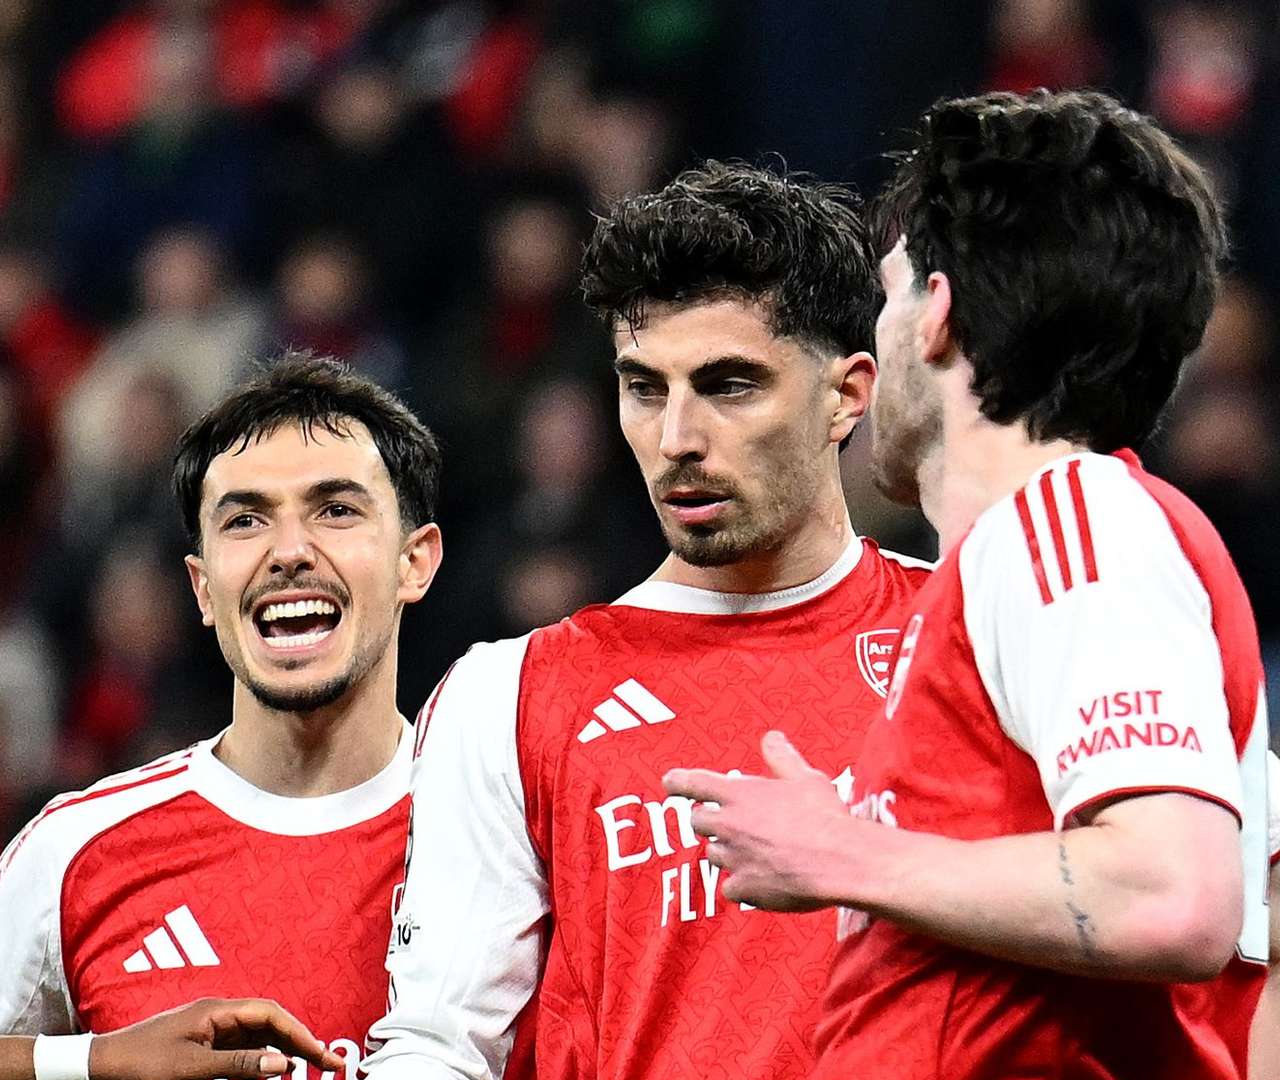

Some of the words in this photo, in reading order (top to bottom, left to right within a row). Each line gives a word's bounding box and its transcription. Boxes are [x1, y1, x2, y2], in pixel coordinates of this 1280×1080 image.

[1079, 690, 1162, 725] VISIT
[1057, 722, 1202, 778] RWANDA
[661, 859, 719, 928] FLY
